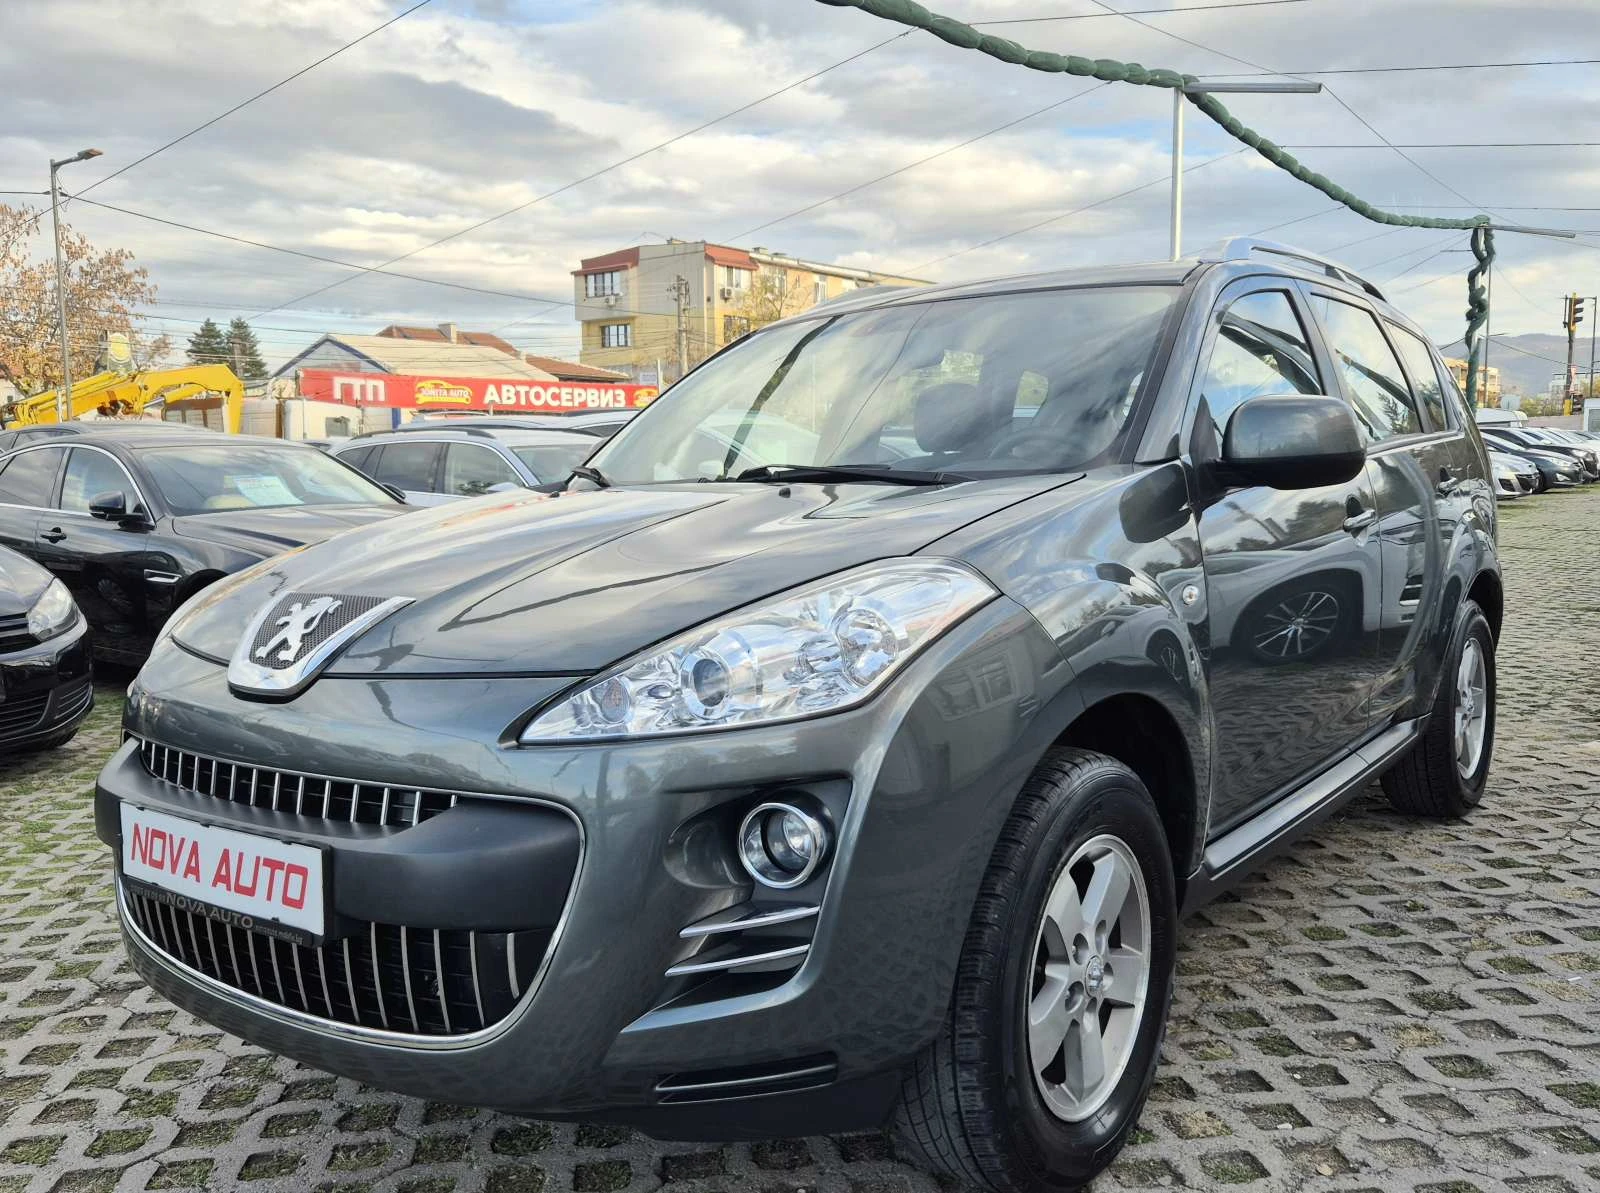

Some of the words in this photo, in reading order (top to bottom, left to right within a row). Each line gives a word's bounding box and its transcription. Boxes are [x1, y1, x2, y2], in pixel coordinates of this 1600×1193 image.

[483, 384, 626, 408] АВТОСЕРВИЗ
[131, 823, 200, 883] NOVA
[212, 848, 308, 910] AUTO
[166, 892, 207, 916] NOVA
[210, 907, 253, 929] AUTO
